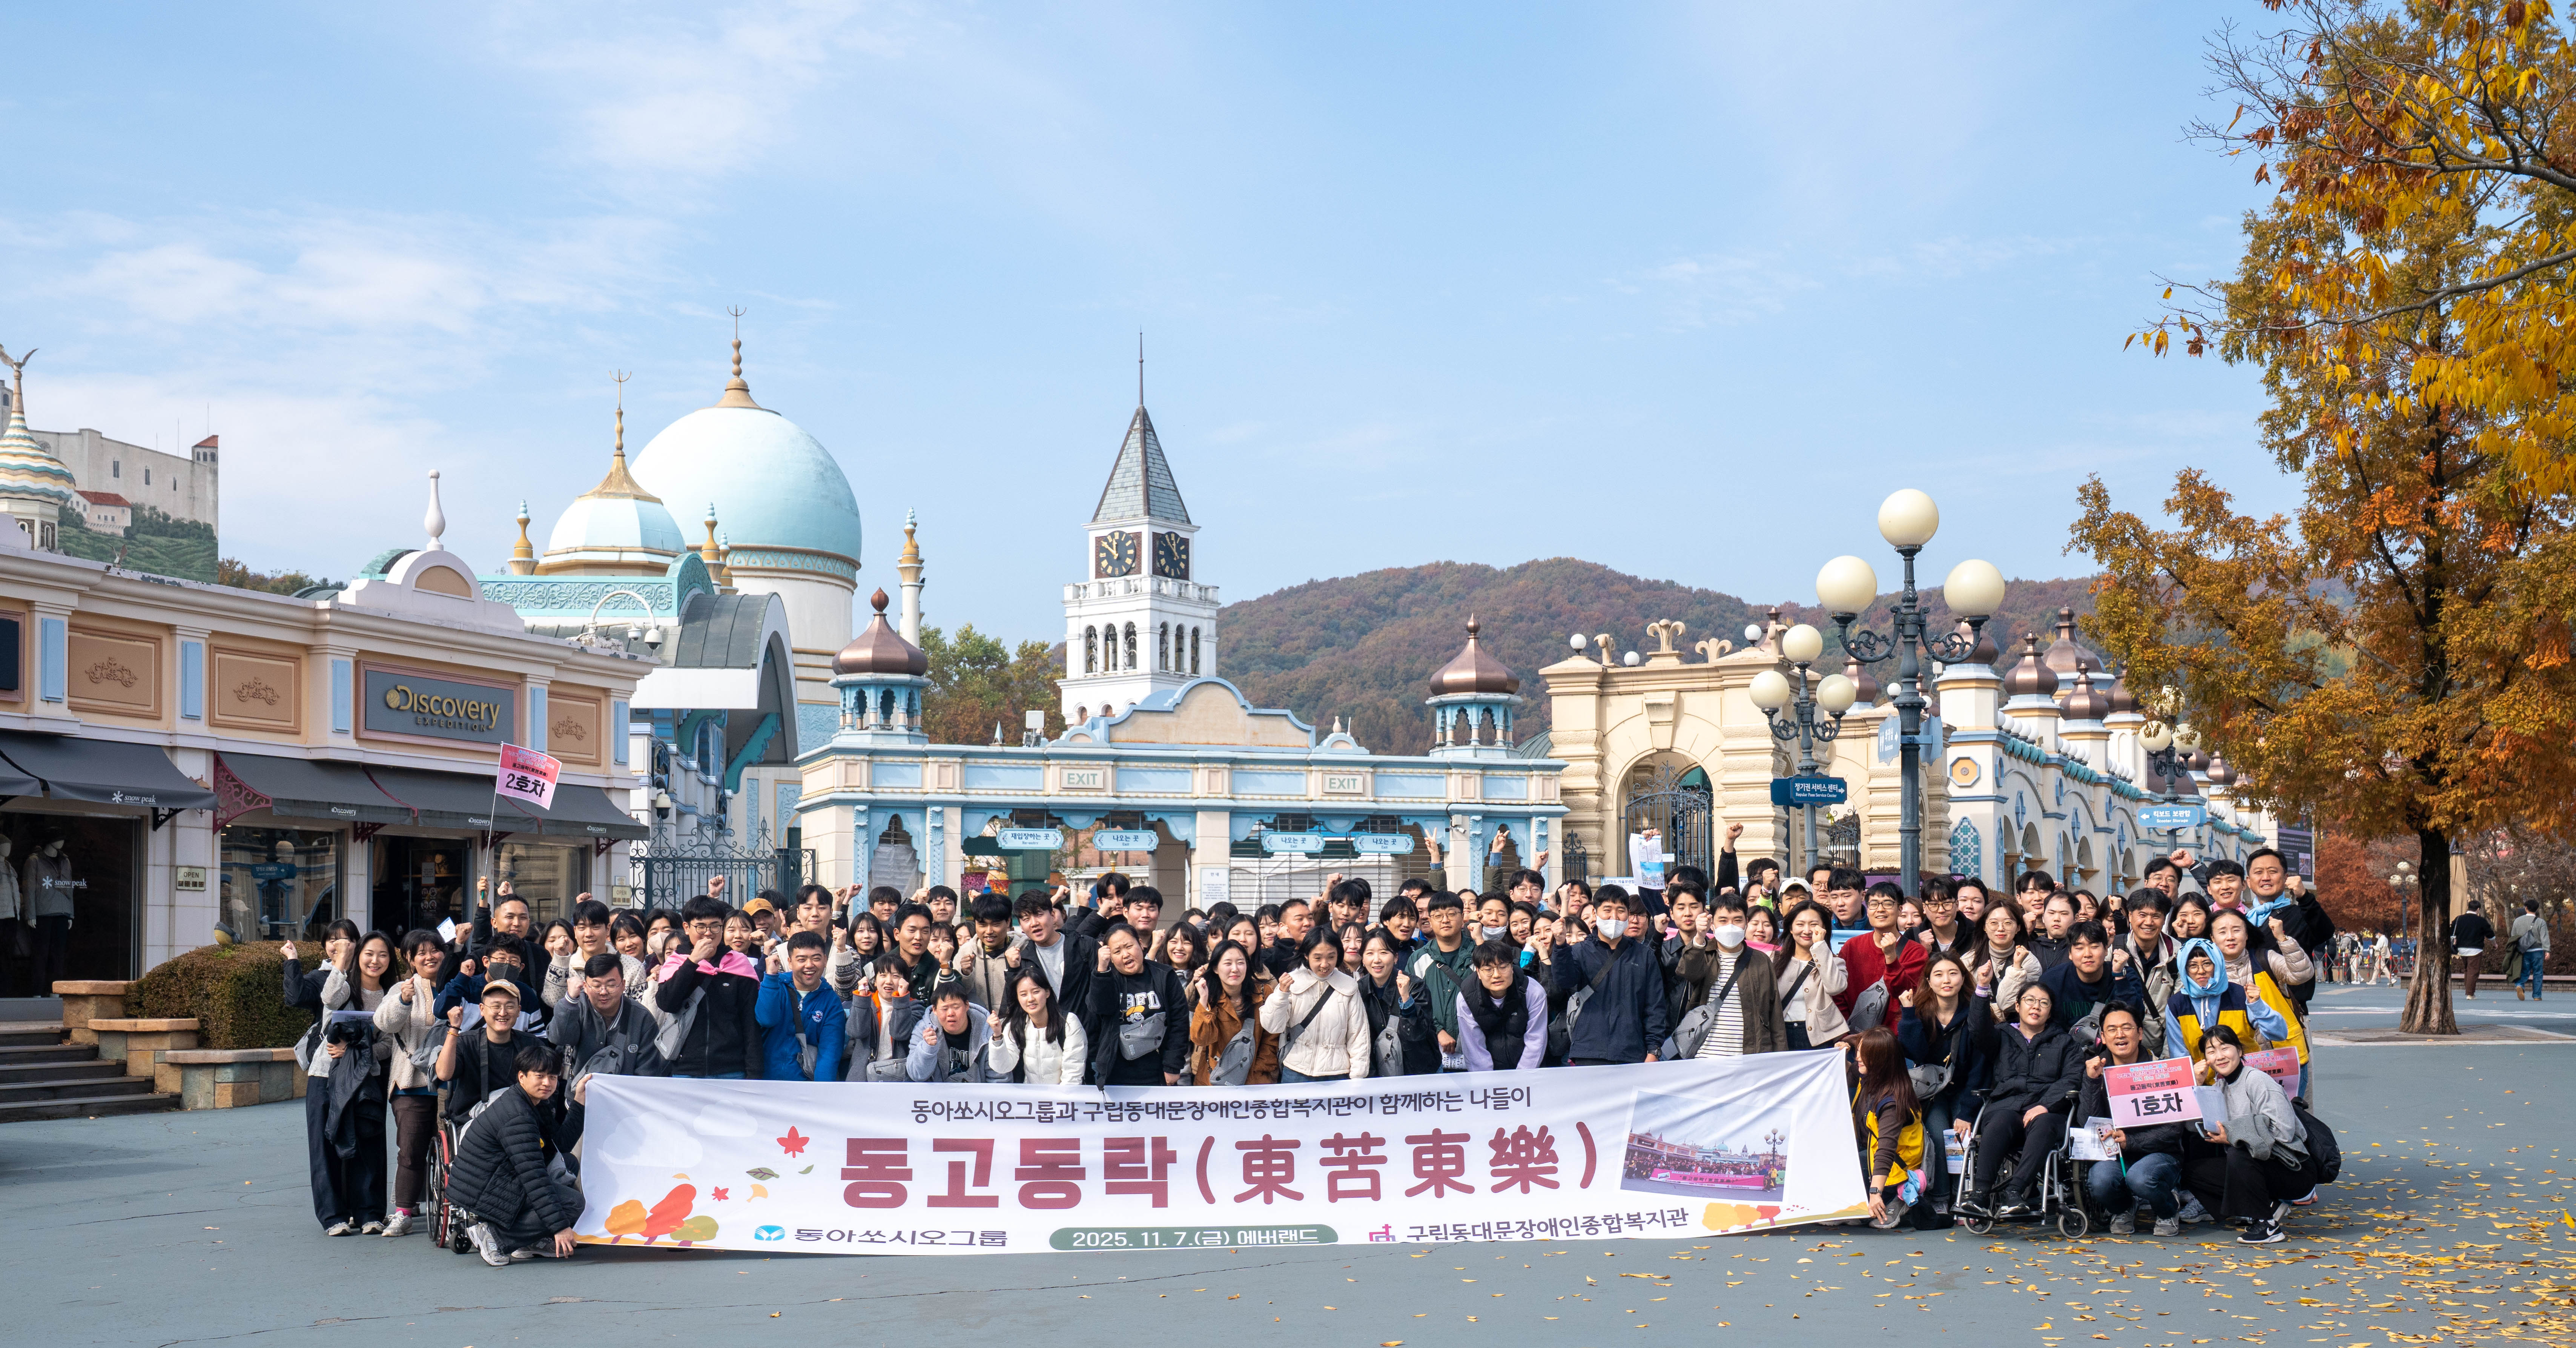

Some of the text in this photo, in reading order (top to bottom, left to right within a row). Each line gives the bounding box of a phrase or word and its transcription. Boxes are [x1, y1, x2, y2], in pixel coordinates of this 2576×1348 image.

[397, 685, 500, 729] Discovery
[416, 716, 486, 732] EXPEDITION
[505, 773, 545, 798] 2호차
[1067, 773, 1098, 785] EXIT
[1329, 778, 1357, 789] EXIT
[1795, 783, 1838, 792] 정기권 서비스 센터
[141, 795, 156, 804] peak
[333, 807, 356, 816] Discovery
[470, 817, 490, 825] Discovery
[588, 825, 607, 833] Discovery
[72, 878, 87, 888] peak
[2130, 1079, 2178, 1091] 동고동락(東苦東樂)
[911, 1086, 1531, 1124] 동아쏘시오그룹과 구립동대문장애인종합복지관이 함께하는 나들이
[2131, 1092, 2183, 1117] 1호차
[841, 1121, 1597, 1209] 동고동락(東苦東樂)
[1407, 1207, 1689, 1241] 구립동대문장애인종합복지관
[794, 1228, 1008, 1247] 동아쏘시오그룹
[1073, 1229, 1320, 1247] 2025. 11. 7.(금) 에버랜드
